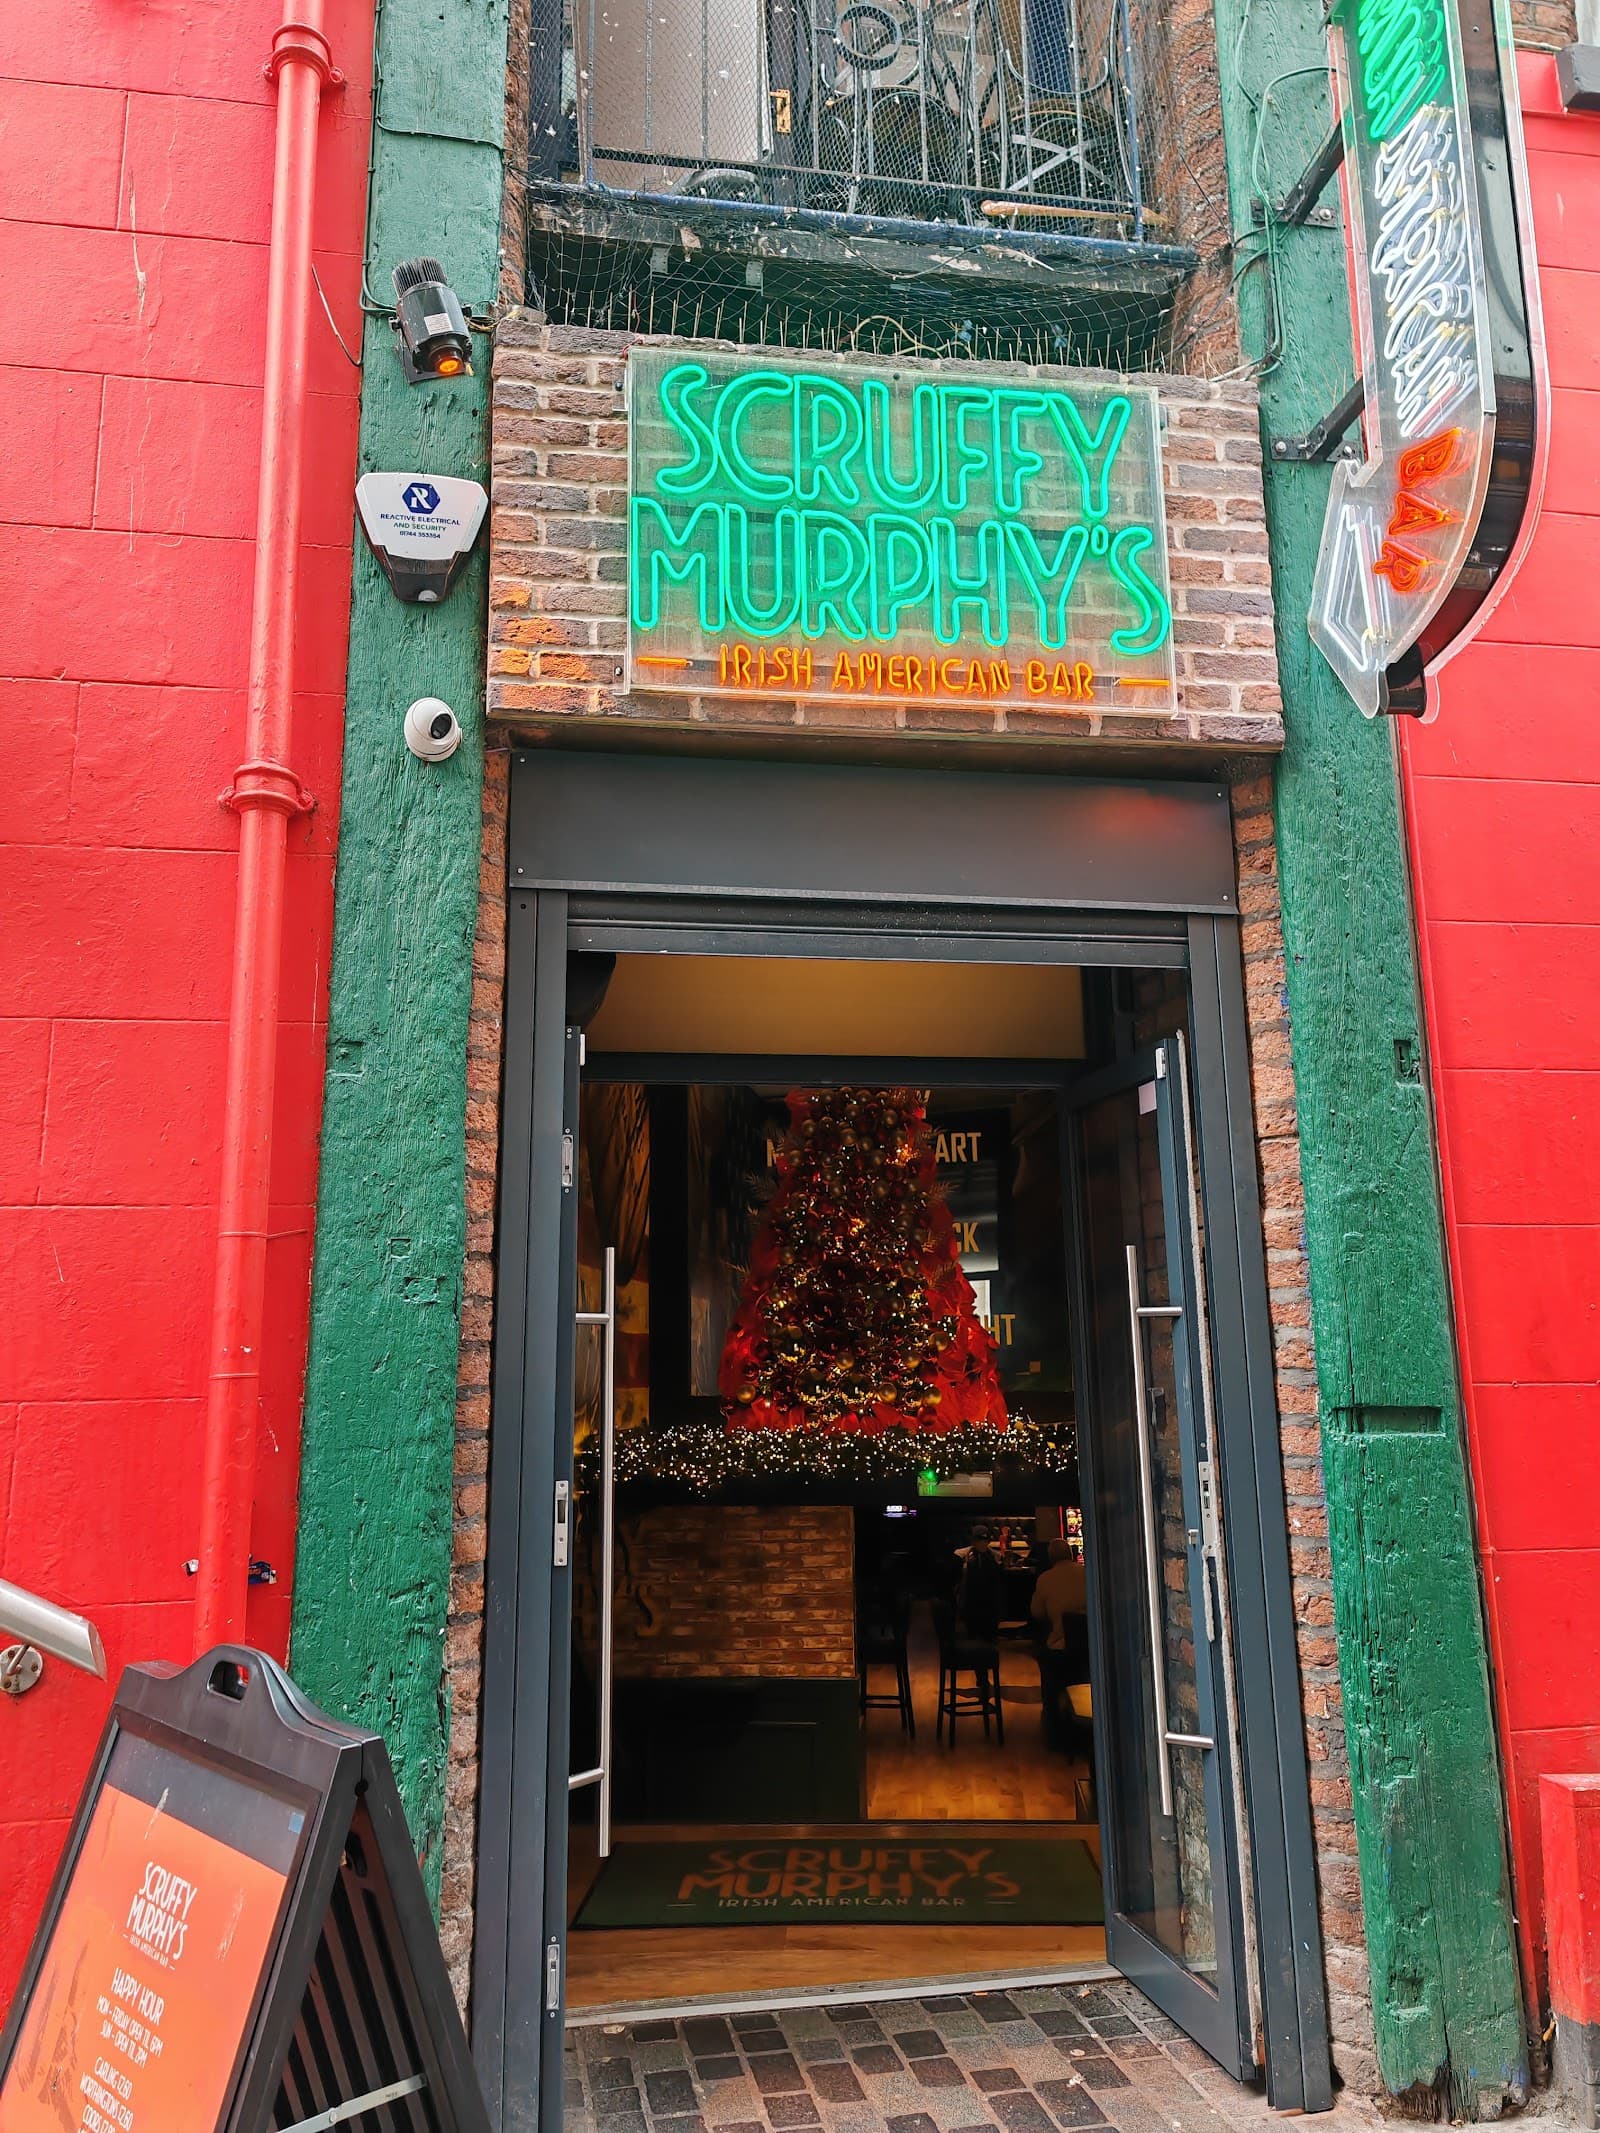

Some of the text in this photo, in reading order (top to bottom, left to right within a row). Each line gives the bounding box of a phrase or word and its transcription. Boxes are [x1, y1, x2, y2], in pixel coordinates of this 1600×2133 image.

[1371, 104, 1462, 437] AMERICAN
[656, 364, 1132, 519] SCRUFFY
[380, 513, 461, 526] REACTIVE ELECTRICAL
[411, 523, 447, 532] SECURITY
[1373, 427, 1462, 592] BAR
[631, 497, 1170, 655] MURPHY'S
[718, 643, 1095, 700] IRISH AMERICAN BAR
[678, 1871, 1021, 1900] MURPHY'S
[704, 1847, 993, 1873] SCRUFFY
[139, 1861, 198, 1920] SCRUFFY
[718, 1897, 966, 1908] IRISH AMERICAN BAR
[126, 1894, 188, 1960] MURPHY'S
[96, 1994, 110, 2016] MON
[128, 2019, 144, 2041] OPEN
[111, 1967, 165, 2026] HAPPY HOUR
[114, 2030, 129, 2053] OPEN
[94, 2056, 119, 2089] CARLING
